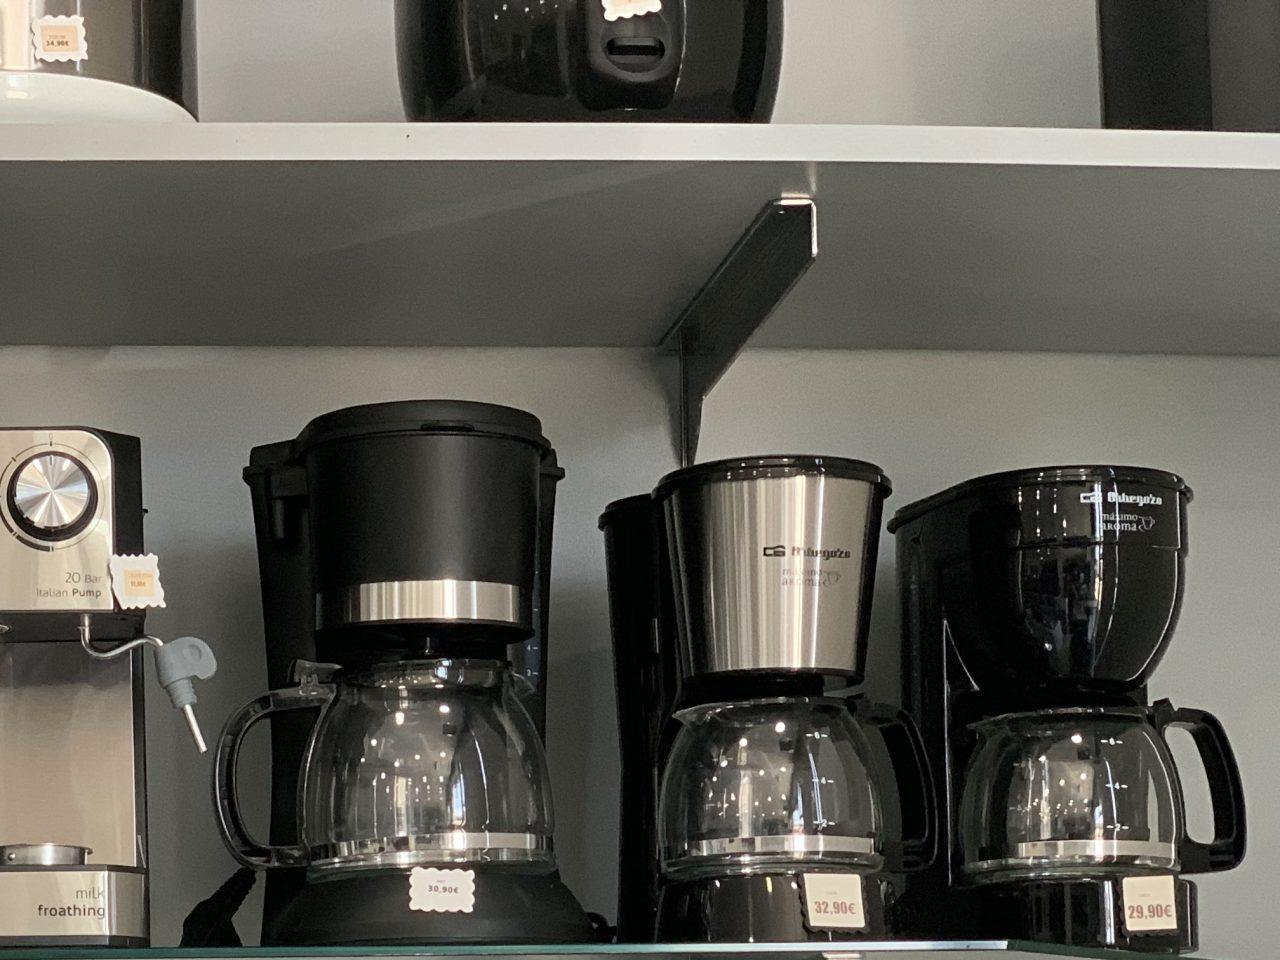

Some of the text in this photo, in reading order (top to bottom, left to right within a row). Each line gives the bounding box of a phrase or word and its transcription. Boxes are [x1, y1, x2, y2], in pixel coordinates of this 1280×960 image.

[65, 572, 102, 584] 20 Bar
[36, 587, 102, 599] Italian Pump
[75, 887, 105, 899] milk
[428, 885, 459, 894] 30,90€
[37, 904, 105, 920] froathing
[814, 901, 857, 915] 32,90€
[1127, 904, 1173, 919] 29,90€
